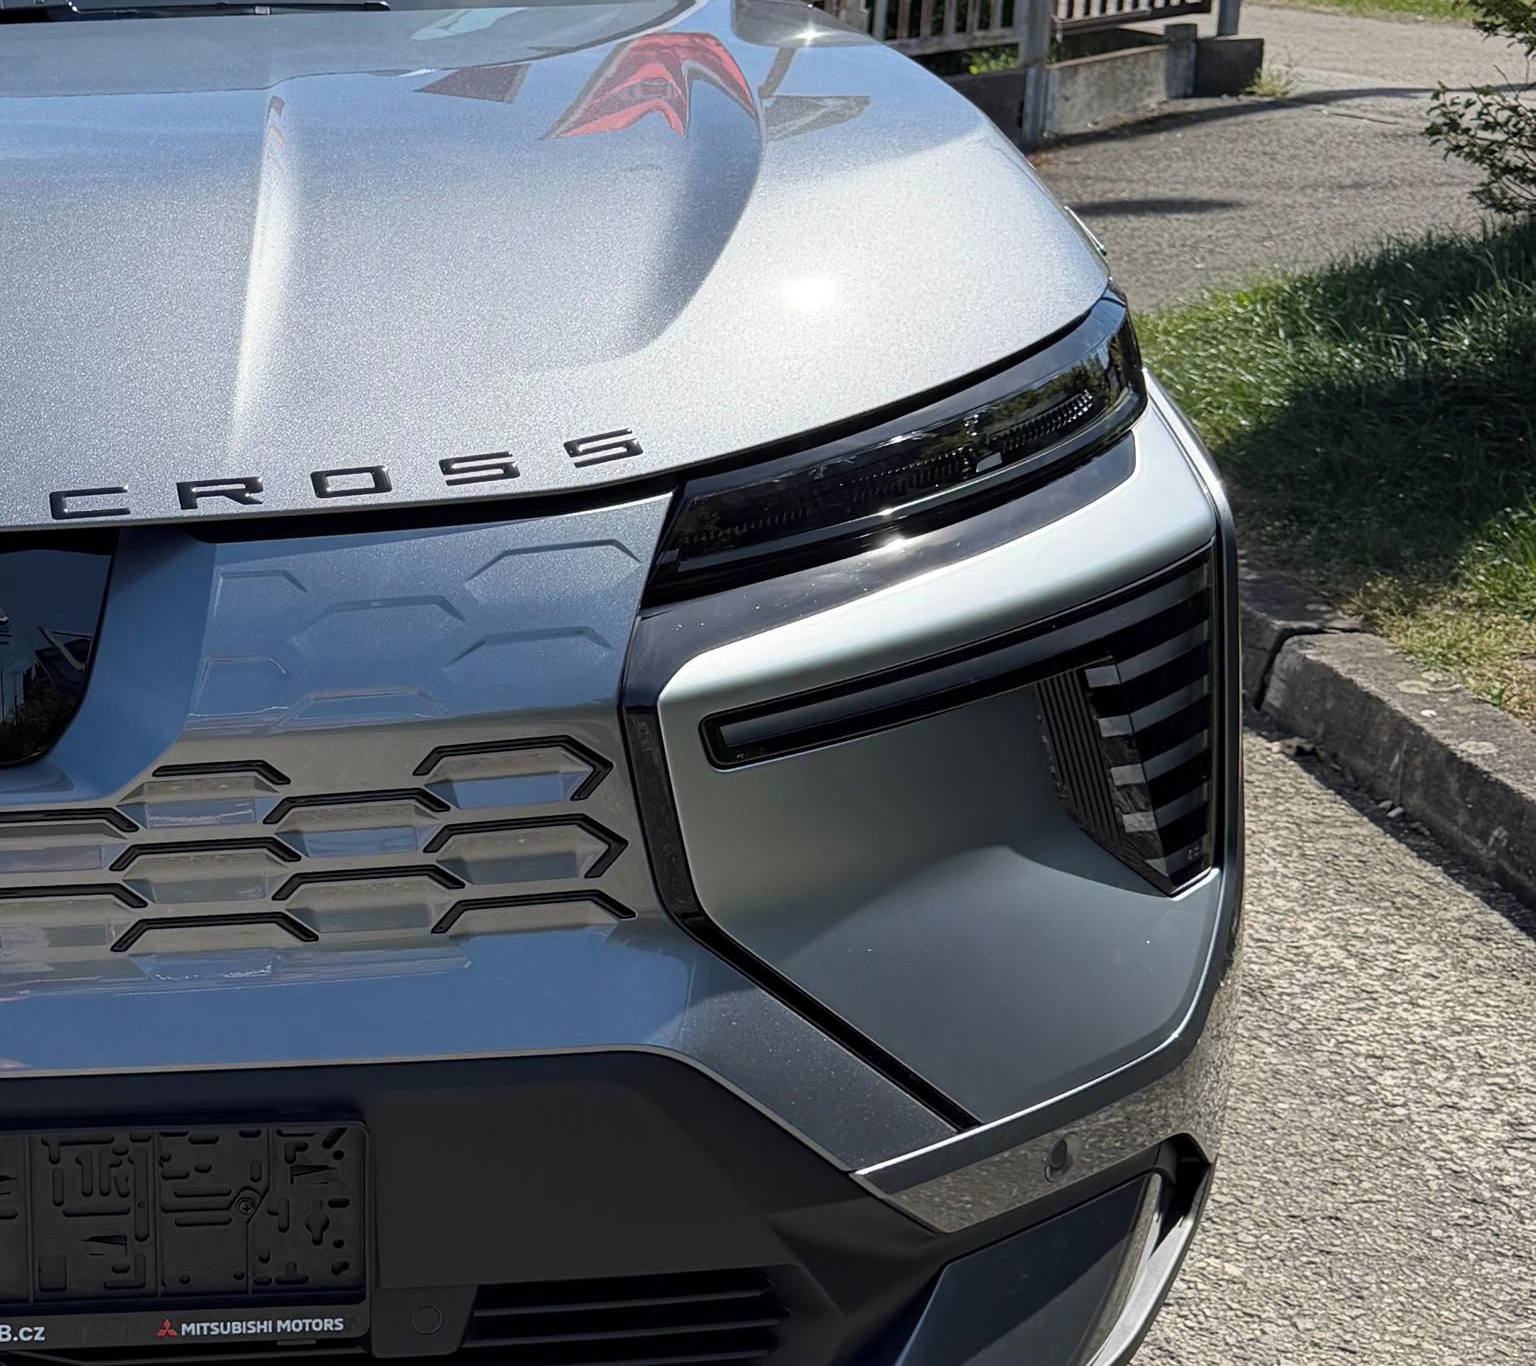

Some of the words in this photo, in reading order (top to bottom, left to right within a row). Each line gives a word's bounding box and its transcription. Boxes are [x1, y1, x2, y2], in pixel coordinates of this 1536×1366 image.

[49, 427, 645, 521] CROSS
[181, 1320, 273, 1336] MITSUBISHI
[276, 1318, 344, 1333] MOTORS
